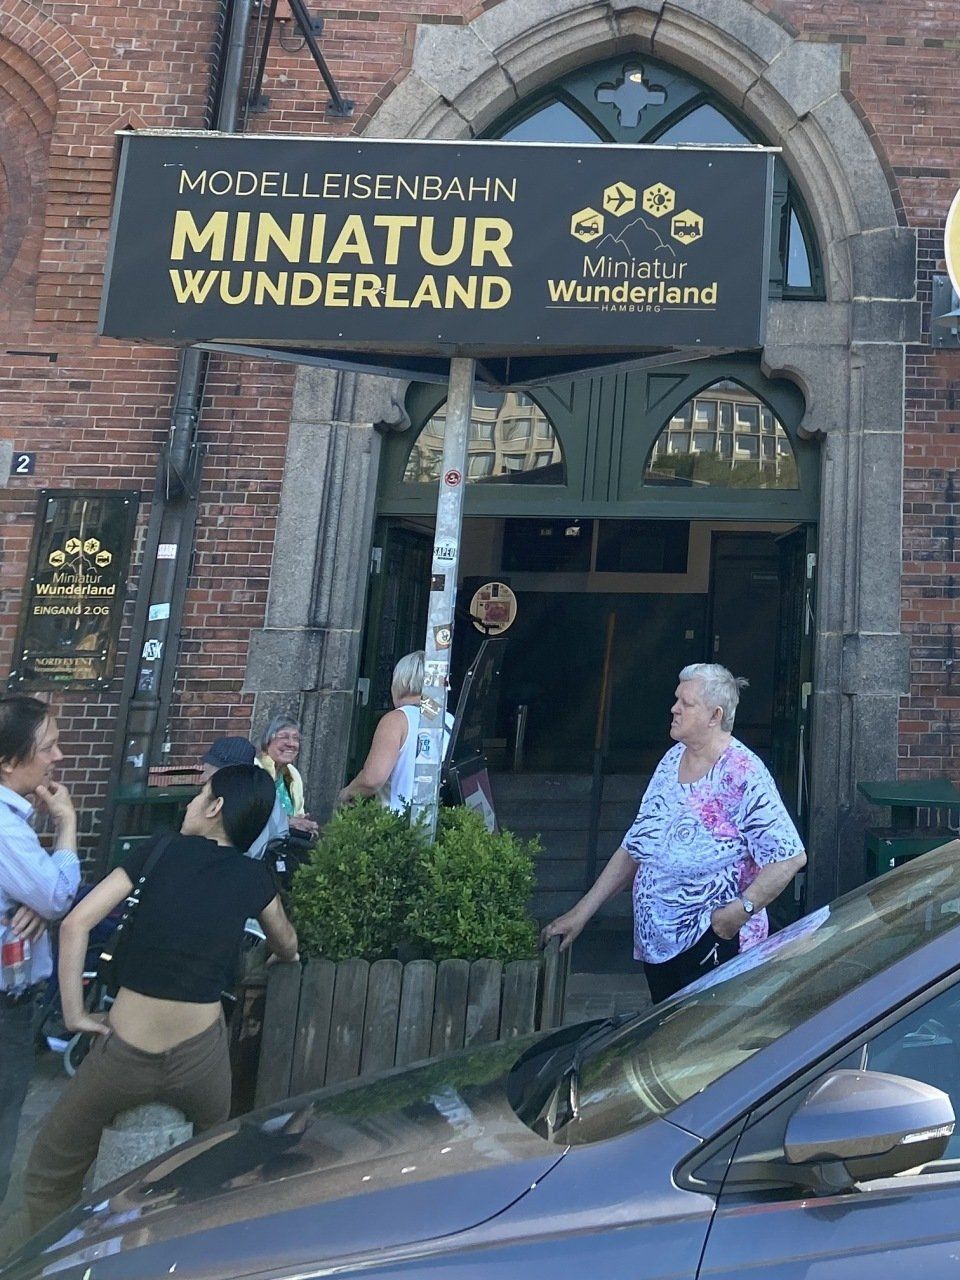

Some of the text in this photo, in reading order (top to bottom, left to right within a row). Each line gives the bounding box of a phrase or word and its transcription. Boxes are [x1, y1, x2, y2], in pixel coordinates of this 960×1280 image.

[179, 169, 517, 202] MODELLEISENBAHN
[170, 210, 513, 268] MINIATUR
[582, 255, 688, 279] Miniatur
[168, 269, 513, 310] WUNDERLAND
[547, 279, 718, 304] Wunderland
[601, 304, 661, 313] HAMBURG
[16, 455, 30, 473] 2
[52, 572, 102, 584] Miniatur
[36, 584, 116, 595] Wunderland
[33, 606, 81, 615] EINGANG
